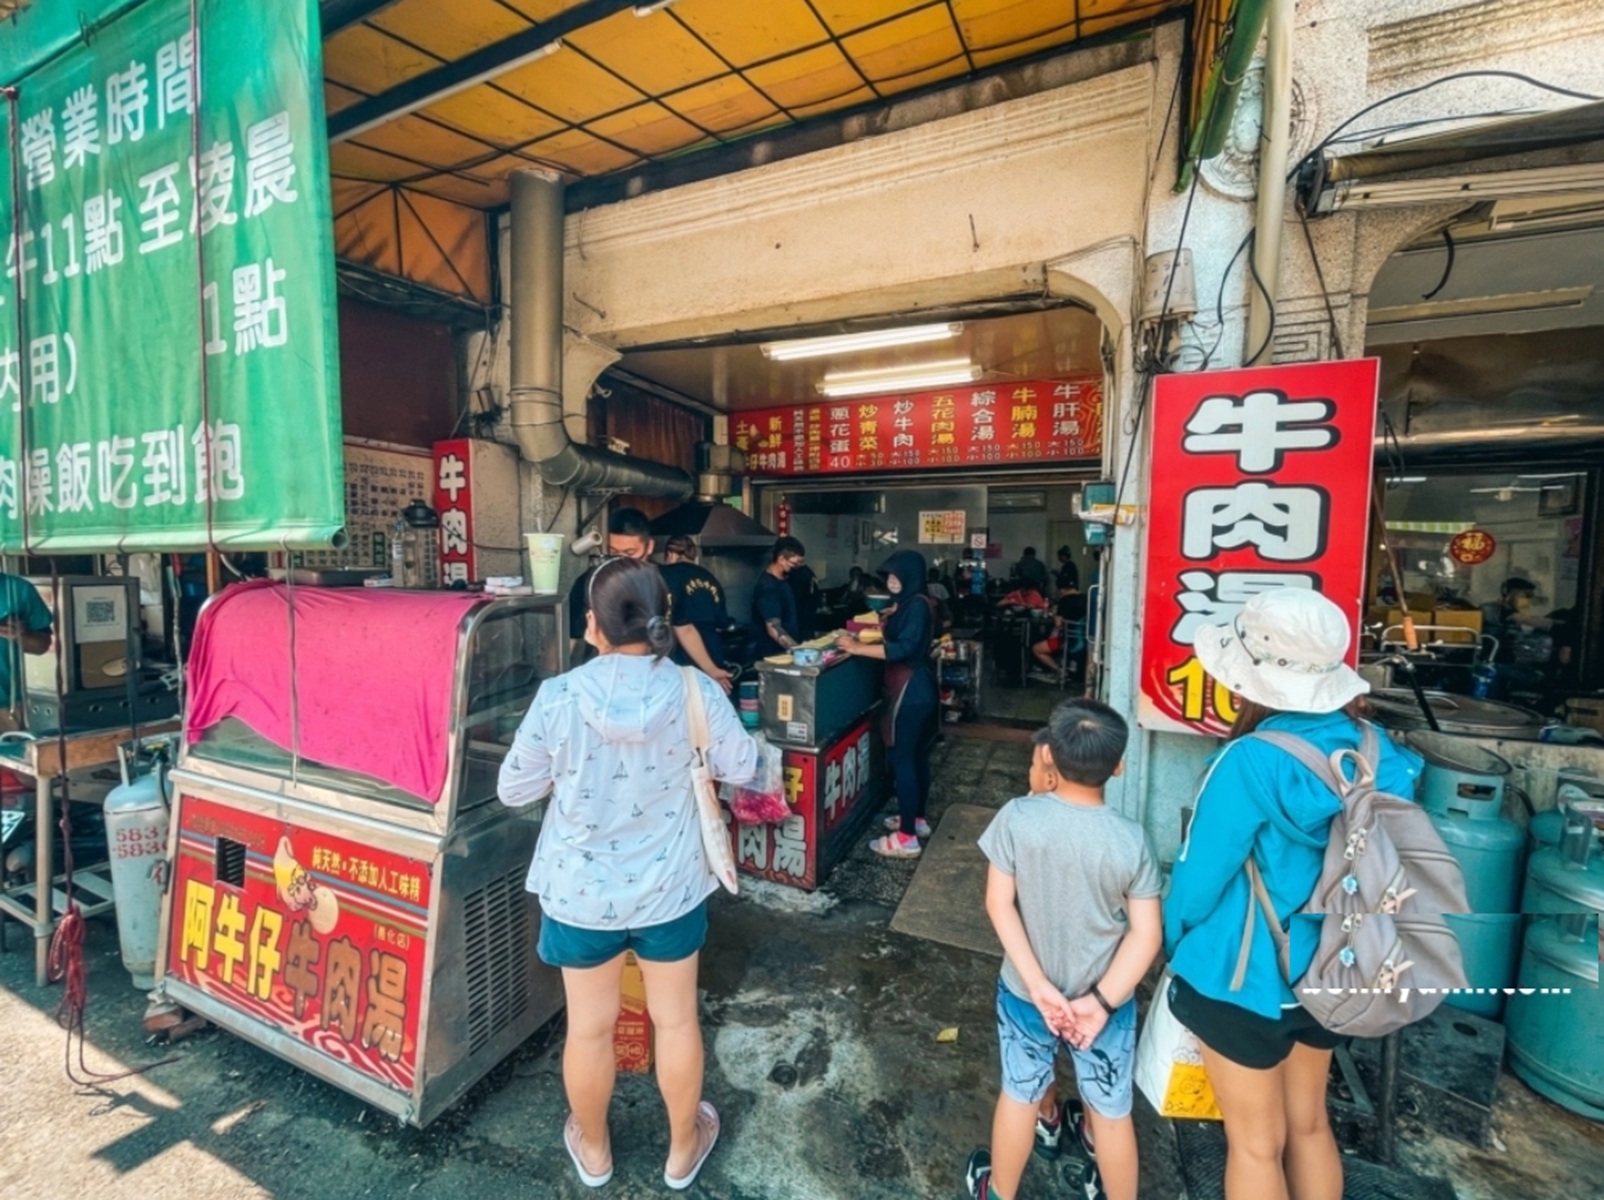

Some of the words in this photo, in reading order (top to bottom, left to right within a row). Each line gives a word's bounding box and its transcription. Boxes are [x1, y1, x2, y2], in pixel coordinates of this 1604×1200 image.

[20, 28, 200, 190] 營業時間
[202, 257, 287, 356] 1點
[859, 404, 878, 450] 炒青菜
[893, 400, 914, 448] 炒牛肉
[970, 390, 996, 441] 綜合湯
[1011, 387, 1038, 439] 牛腩湯
[1053, 384, 1080, 437] 牛肝湯
[829, 455, 850, 468] 40
[824, 730, 870, 820] 牛肉湯
[116, 825, 169, 842] 583
